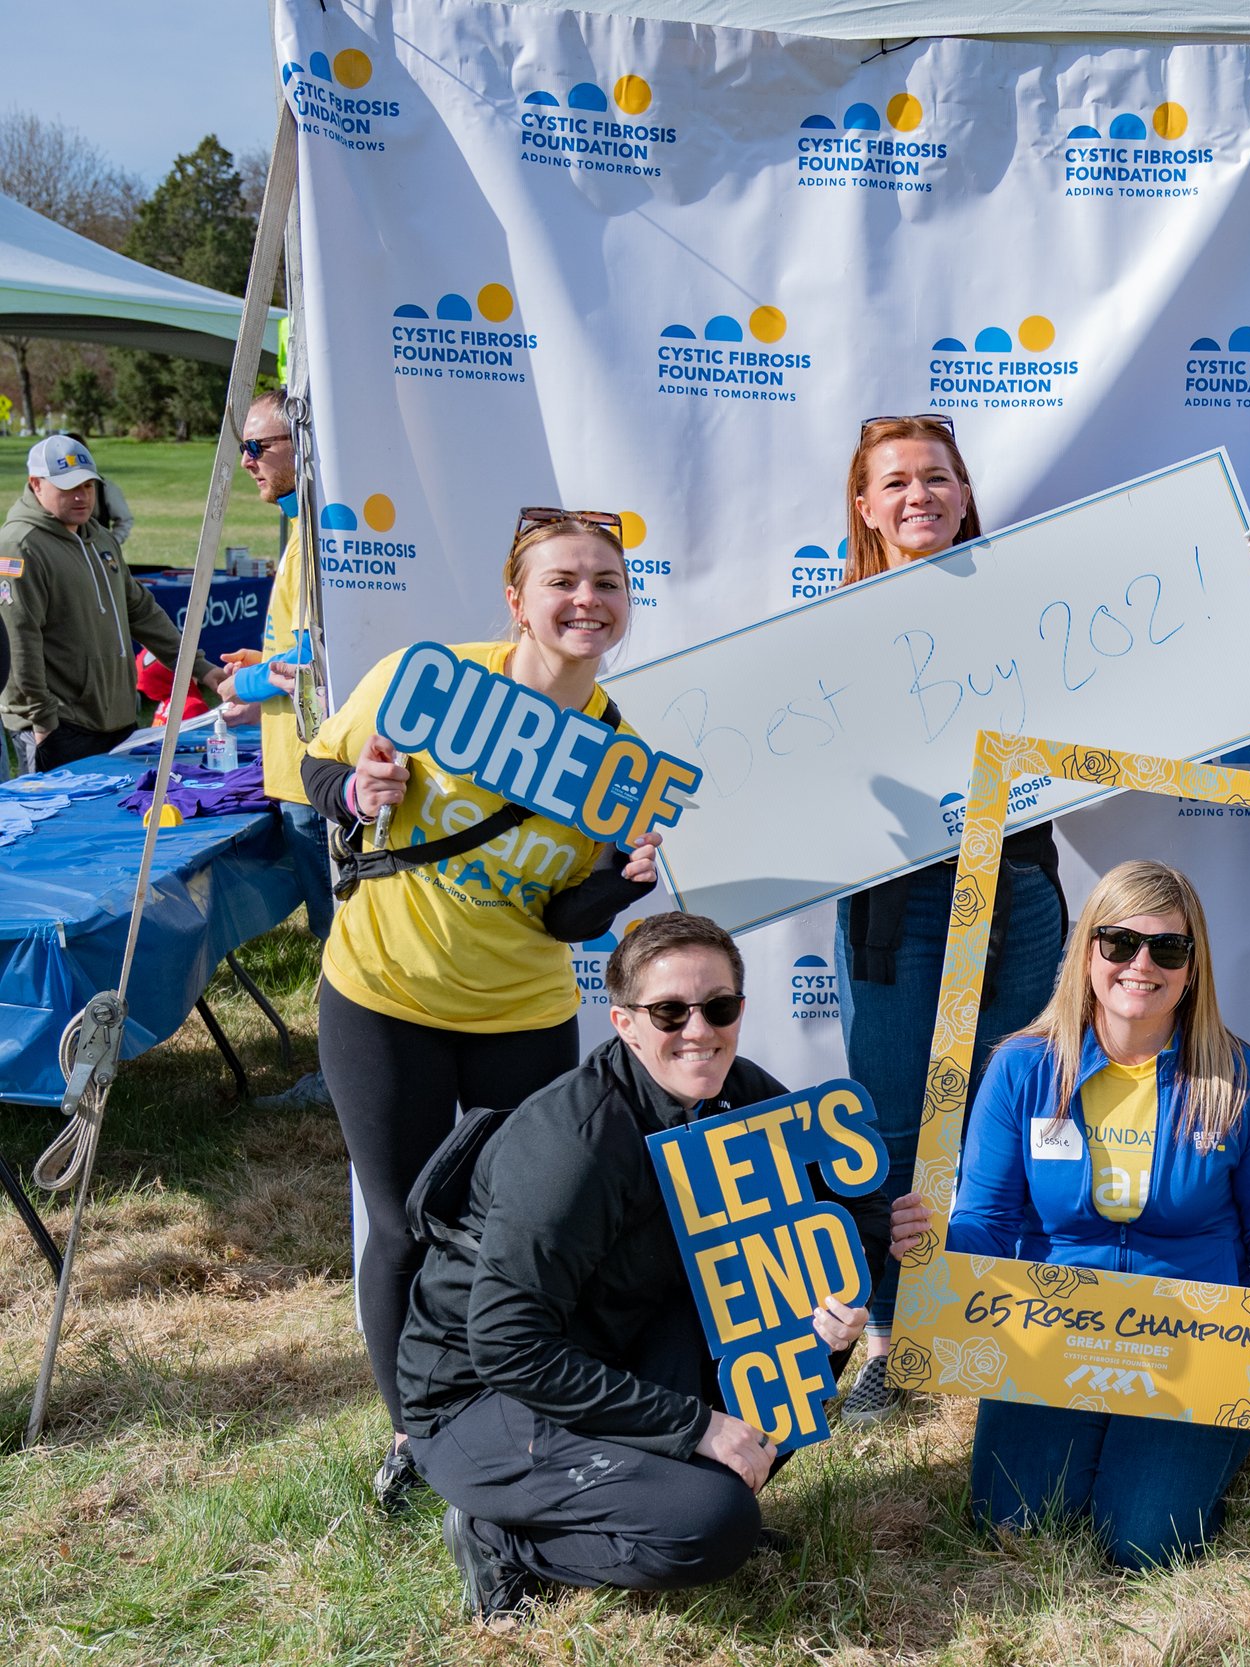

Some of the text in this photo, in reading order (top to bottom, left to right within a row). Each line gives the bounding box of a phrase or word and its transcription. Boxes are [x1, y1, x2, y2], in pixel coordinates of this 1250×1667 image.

[521, 113, 676, 143] CYSTIC FIBROSIS
[521, 130, 647, 162] FOUNDATION
[798, 137, 947, 158] CYSTIC FIBROSIS
[521, 152, 661, 176] ADDING TOMORROWS
[1065, 148, 1213, 164] CYSTIC FIBROSIS
[799, 156, 919, 175] FOUNDATION
[1066, 166, 1186, 182] FOUNDATION
[798, 178, 932, 192] ADDING TOMORROWS
[1066, 186, 1199, 198] ADDING TOMORROWS
[393, 326, 537, 349] CYSTIC FIBROSIS
[394, 345, 512, 366] FOUNDATION
[658, 346, 810, 368] CYSTIC FIBROSIS
[395, 366, 525, 382] ADDING TOMORROWS
[659, 364, 783, 385] FOUNDATION
[930, 360, 1078, 375] CYSTIC FIBROSIS
[1187, 360, 1246, 375] CYSTIC
[659, 385, 795, 401] ADDING TOMORROWS
[930, 378, 1051, 392] FOUNDATION
[930, 398, 1063, 408] ADDING TOMORROWS
[1185, 398, 1231, 407] ADDING
[344, 540, 416, 558] FIBROSIS
[792, 567, 843, 581] CYSTI
[329, 579, 406, 591] TOMORROWS
[662, 678, 852, 799] Best
[893, 629, 1027, 745] Buy
[1178, 808, 1223, 817] ADDING
[572, 960, 601, 973] TIC
[791, 975, 836, 988] CYST
[792, 1010, 839, 1018] ADDING
[1036, 1129, 1070, 1148] Jessie
[662, 1090, 878, 1237] LET'S
[695, 1213, 861, 1344] END
[965, 1291, 1012, 1328] 65
[1066, 1335, 1111, 1350] GREAT
[1064, 1352, 1168, 1370] CYSTIC FIBROSIS FOUNDATION
[731, 1334, 825, 1446] CF
